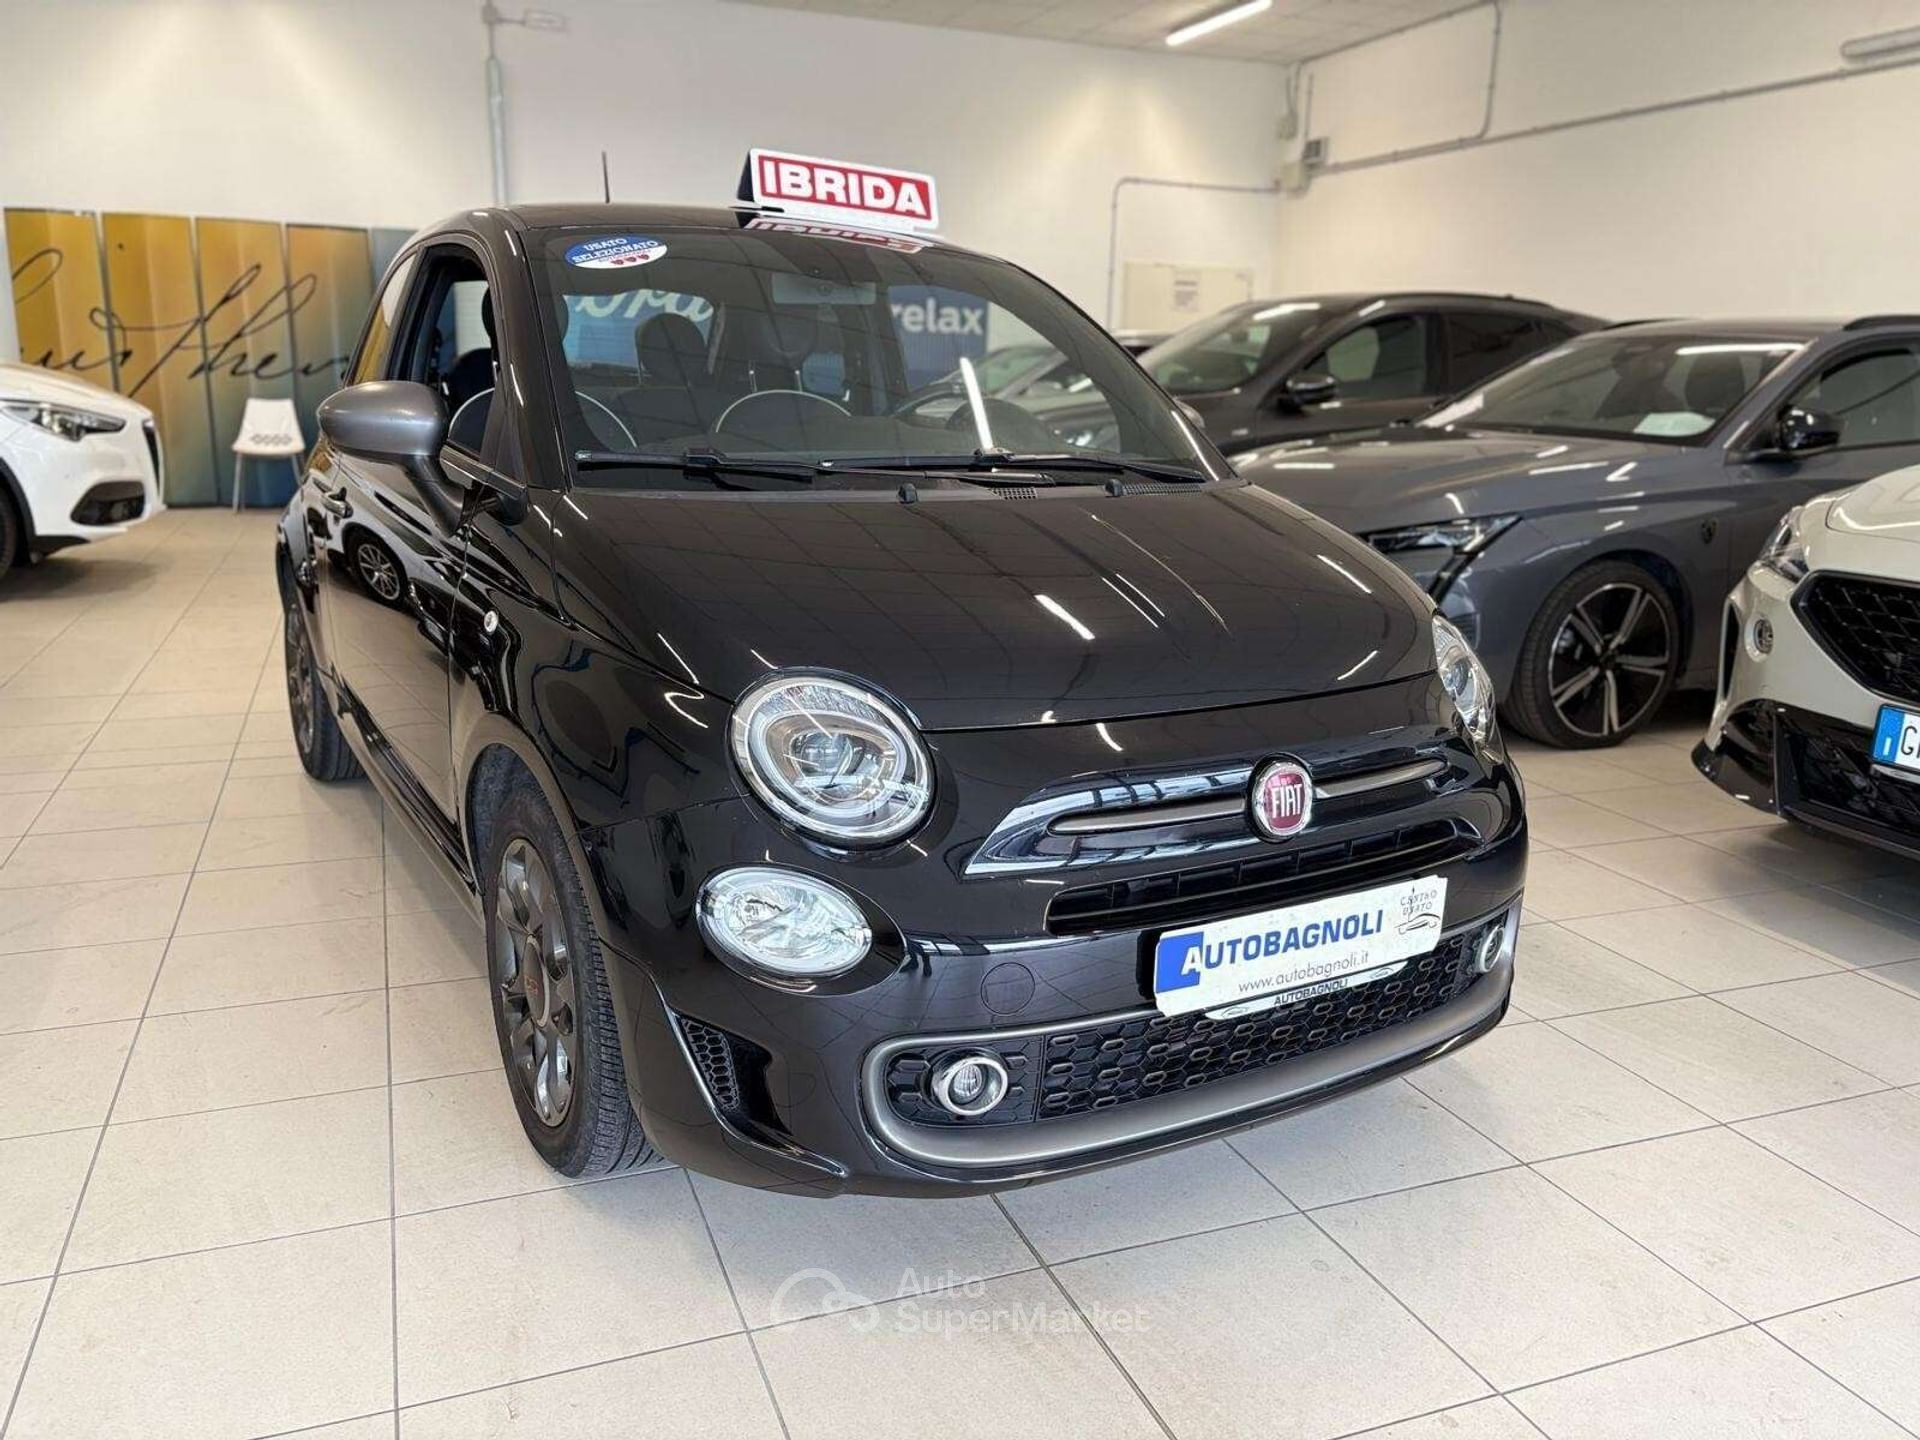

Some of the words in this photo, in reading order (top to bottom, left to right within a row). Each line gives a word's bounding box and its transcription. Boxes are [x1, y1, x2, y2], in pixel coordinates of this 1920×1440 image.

[762, 160, 927, 216] IBRIDA
[571, 240, 659, 263] SELEZIONATO
[583, 237, 628, 251] USATO
[1901, 725, 1920, 759] G
[1270, 783, 1303, 819] FIAT
[1180, 909, 1384, 976] AUTOBAGNOLI
[1237, 949, 1370, 993] www.autobagnoli.it
[1273, 978, 1350, 1006] AUTOBAGNOLI
